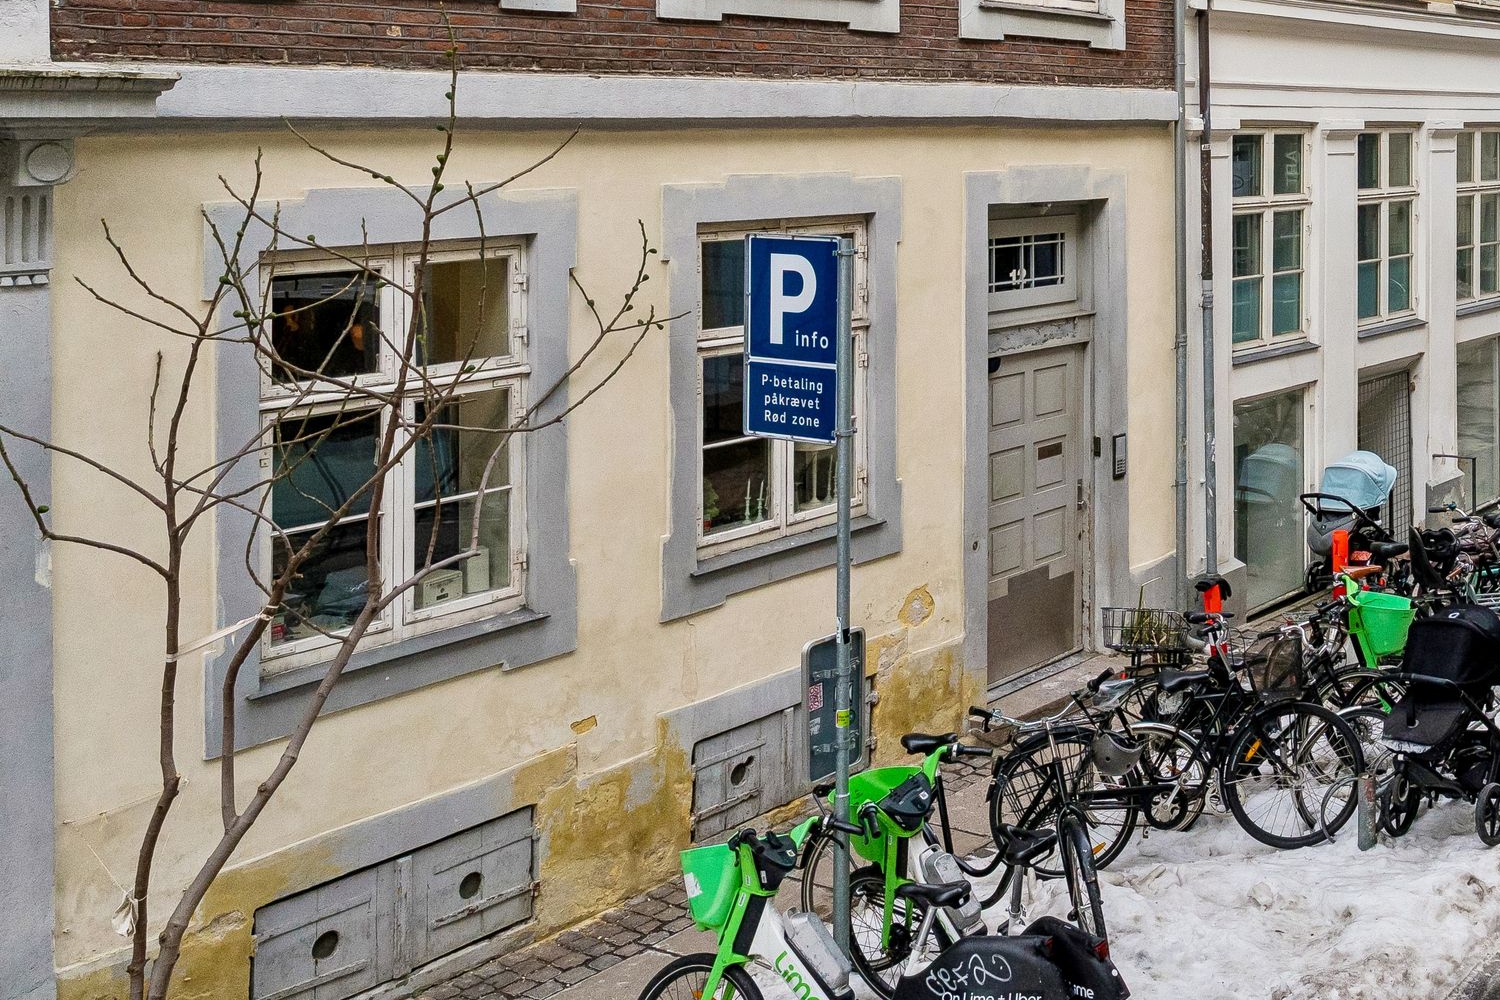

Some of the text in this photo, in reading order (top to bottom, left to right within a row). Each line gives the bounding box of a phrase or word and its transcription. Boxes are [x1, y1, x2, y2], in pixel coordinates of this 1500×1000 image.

[769, 253, 817, 345] P
[795, 330, 829, 349] info
[761, 373, 823, 394] P-betaling
[764, 392, 820, 410] påkrævet
[764, 409, 820, 428] Rød zone
